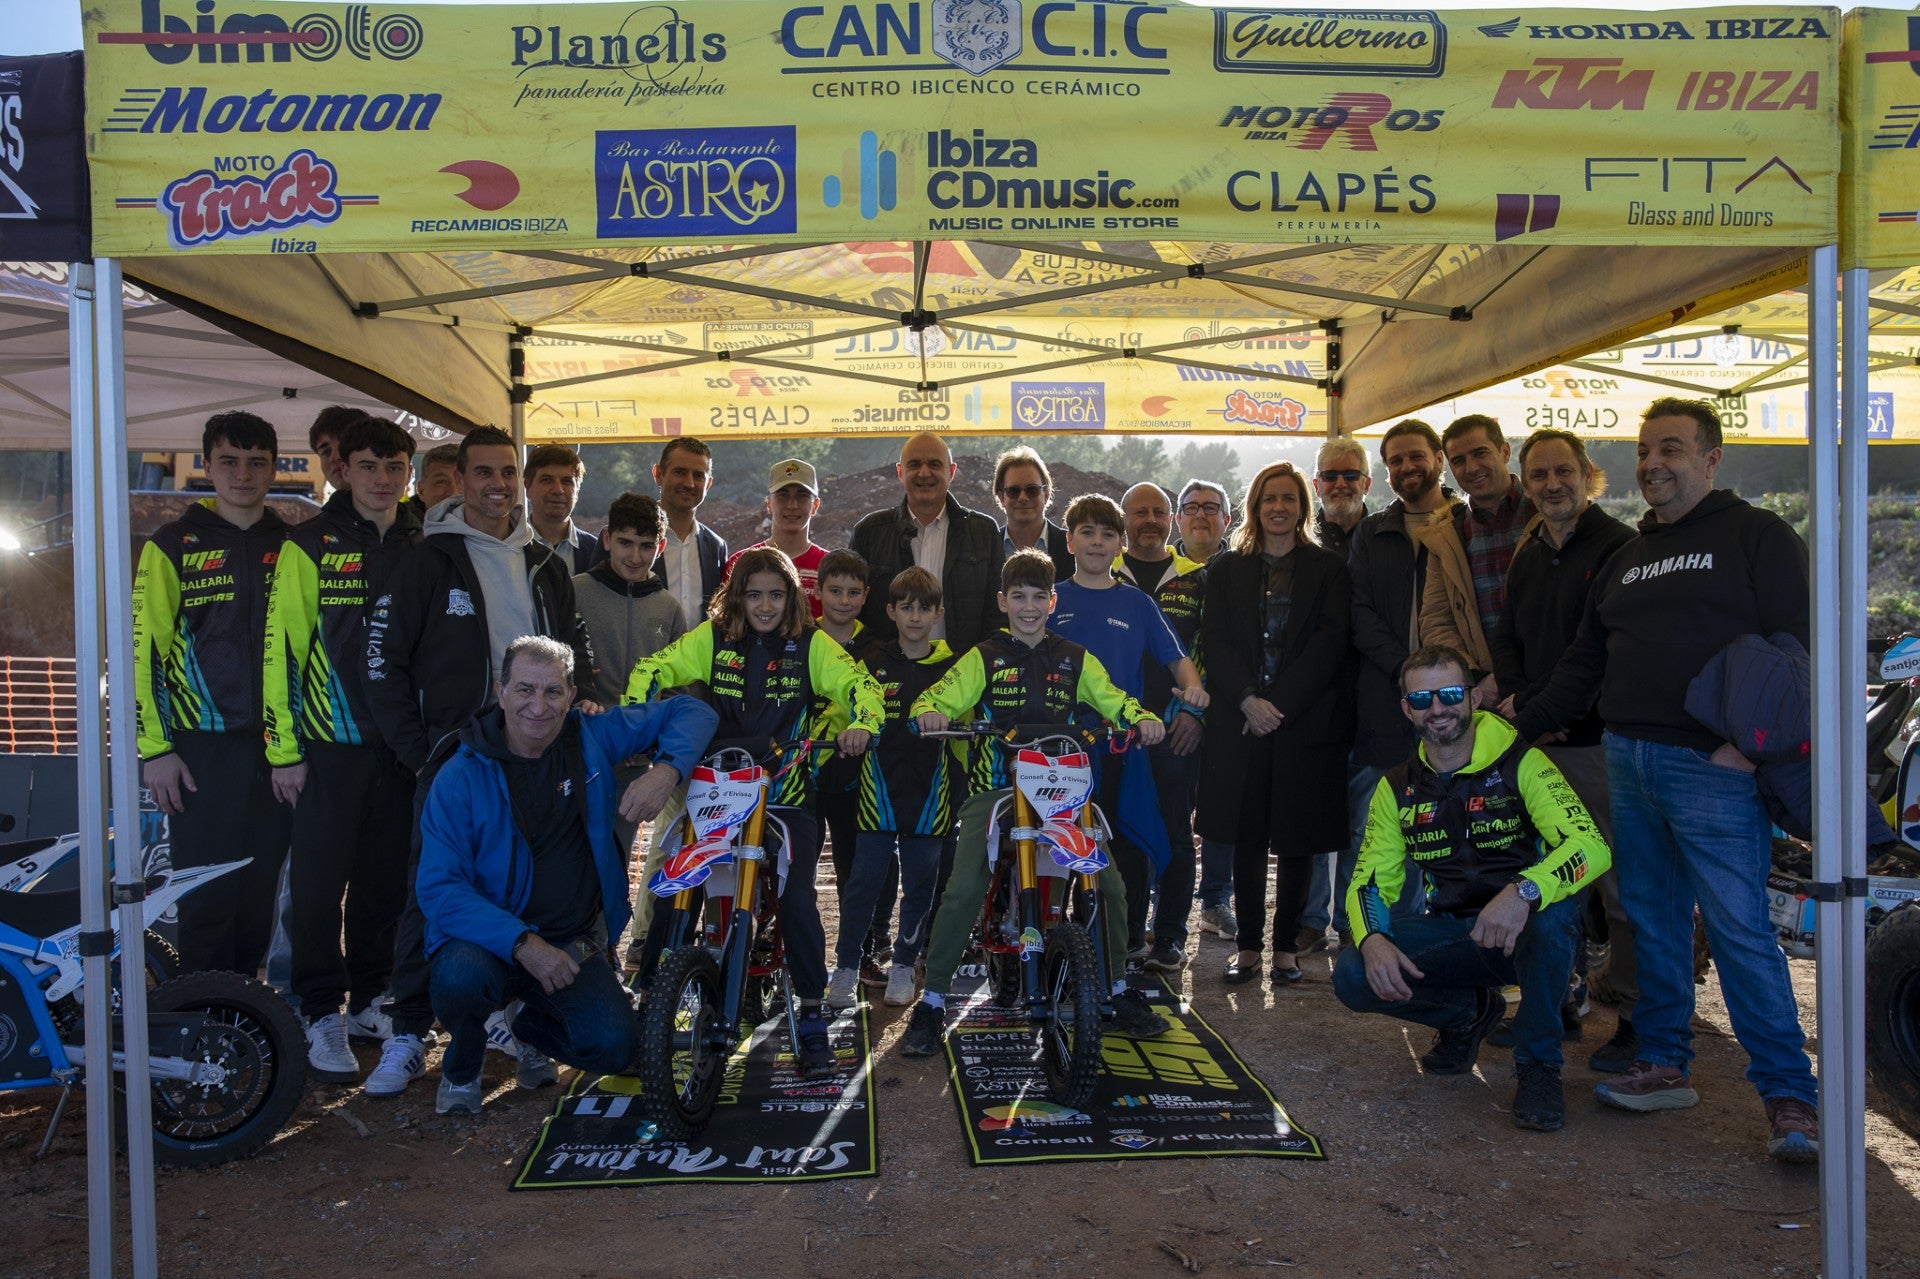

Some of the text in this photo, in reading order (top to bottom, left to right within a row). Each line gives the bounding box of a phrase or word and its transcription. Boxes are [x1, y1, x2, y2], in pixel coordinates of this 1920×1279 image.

[781, 4, 921, 59] CAN
[1232, 15, 1429, 59] Guillermo
[1527, 17, 1831, 41] HONDA IBIZA
[511, 22, 727, 66] Planells
[513, 78, 728, 108] panadería pastelería
[812, 77, 1142, 98] CENTRO IBICENCO CERÁMICO
[1491, 57, 1821, 111] KTM IBIZA
[139, 87, 443, 134] Motomon
[607, 137, 783, 158] Bar Restaurante
[1244, 131, 1290, 142] IBIZA
[927, 129, 1038, 169] Ibiza
[214, 156, 276, 172] MOTO
[1585, 156, 1813, 195] FITA
[170, 150, 336, 241] Track
[609, 157, 786, 226] ASTRO
[1226, 166, 1437, 214] CLAPÉS
[929, 216, 1180, 231] MUSIC ONLINE STORE
[1277, 219, 1382, 231] PERFUMERÍA
[1628, 201, 1774, 228] Glass and Doors
[270, 237, 318, 253] Ibiza
[1306, 234, 1353, 245] IBIZA
[1640, 552, 1713, 581] YAMAHA
[181, 574, 235, 592] BALEARIA
[184, 592, 235, 607] COMAS
[1875, 889, 1915, 900] GALFER
[961, 1032, 1032, 1041] CLAPÉS
[994, 1136, 1094, 1146] Consell
[736, 1140, 857, 1171] Sant
[762, 1166, 808, 1175] Visit
